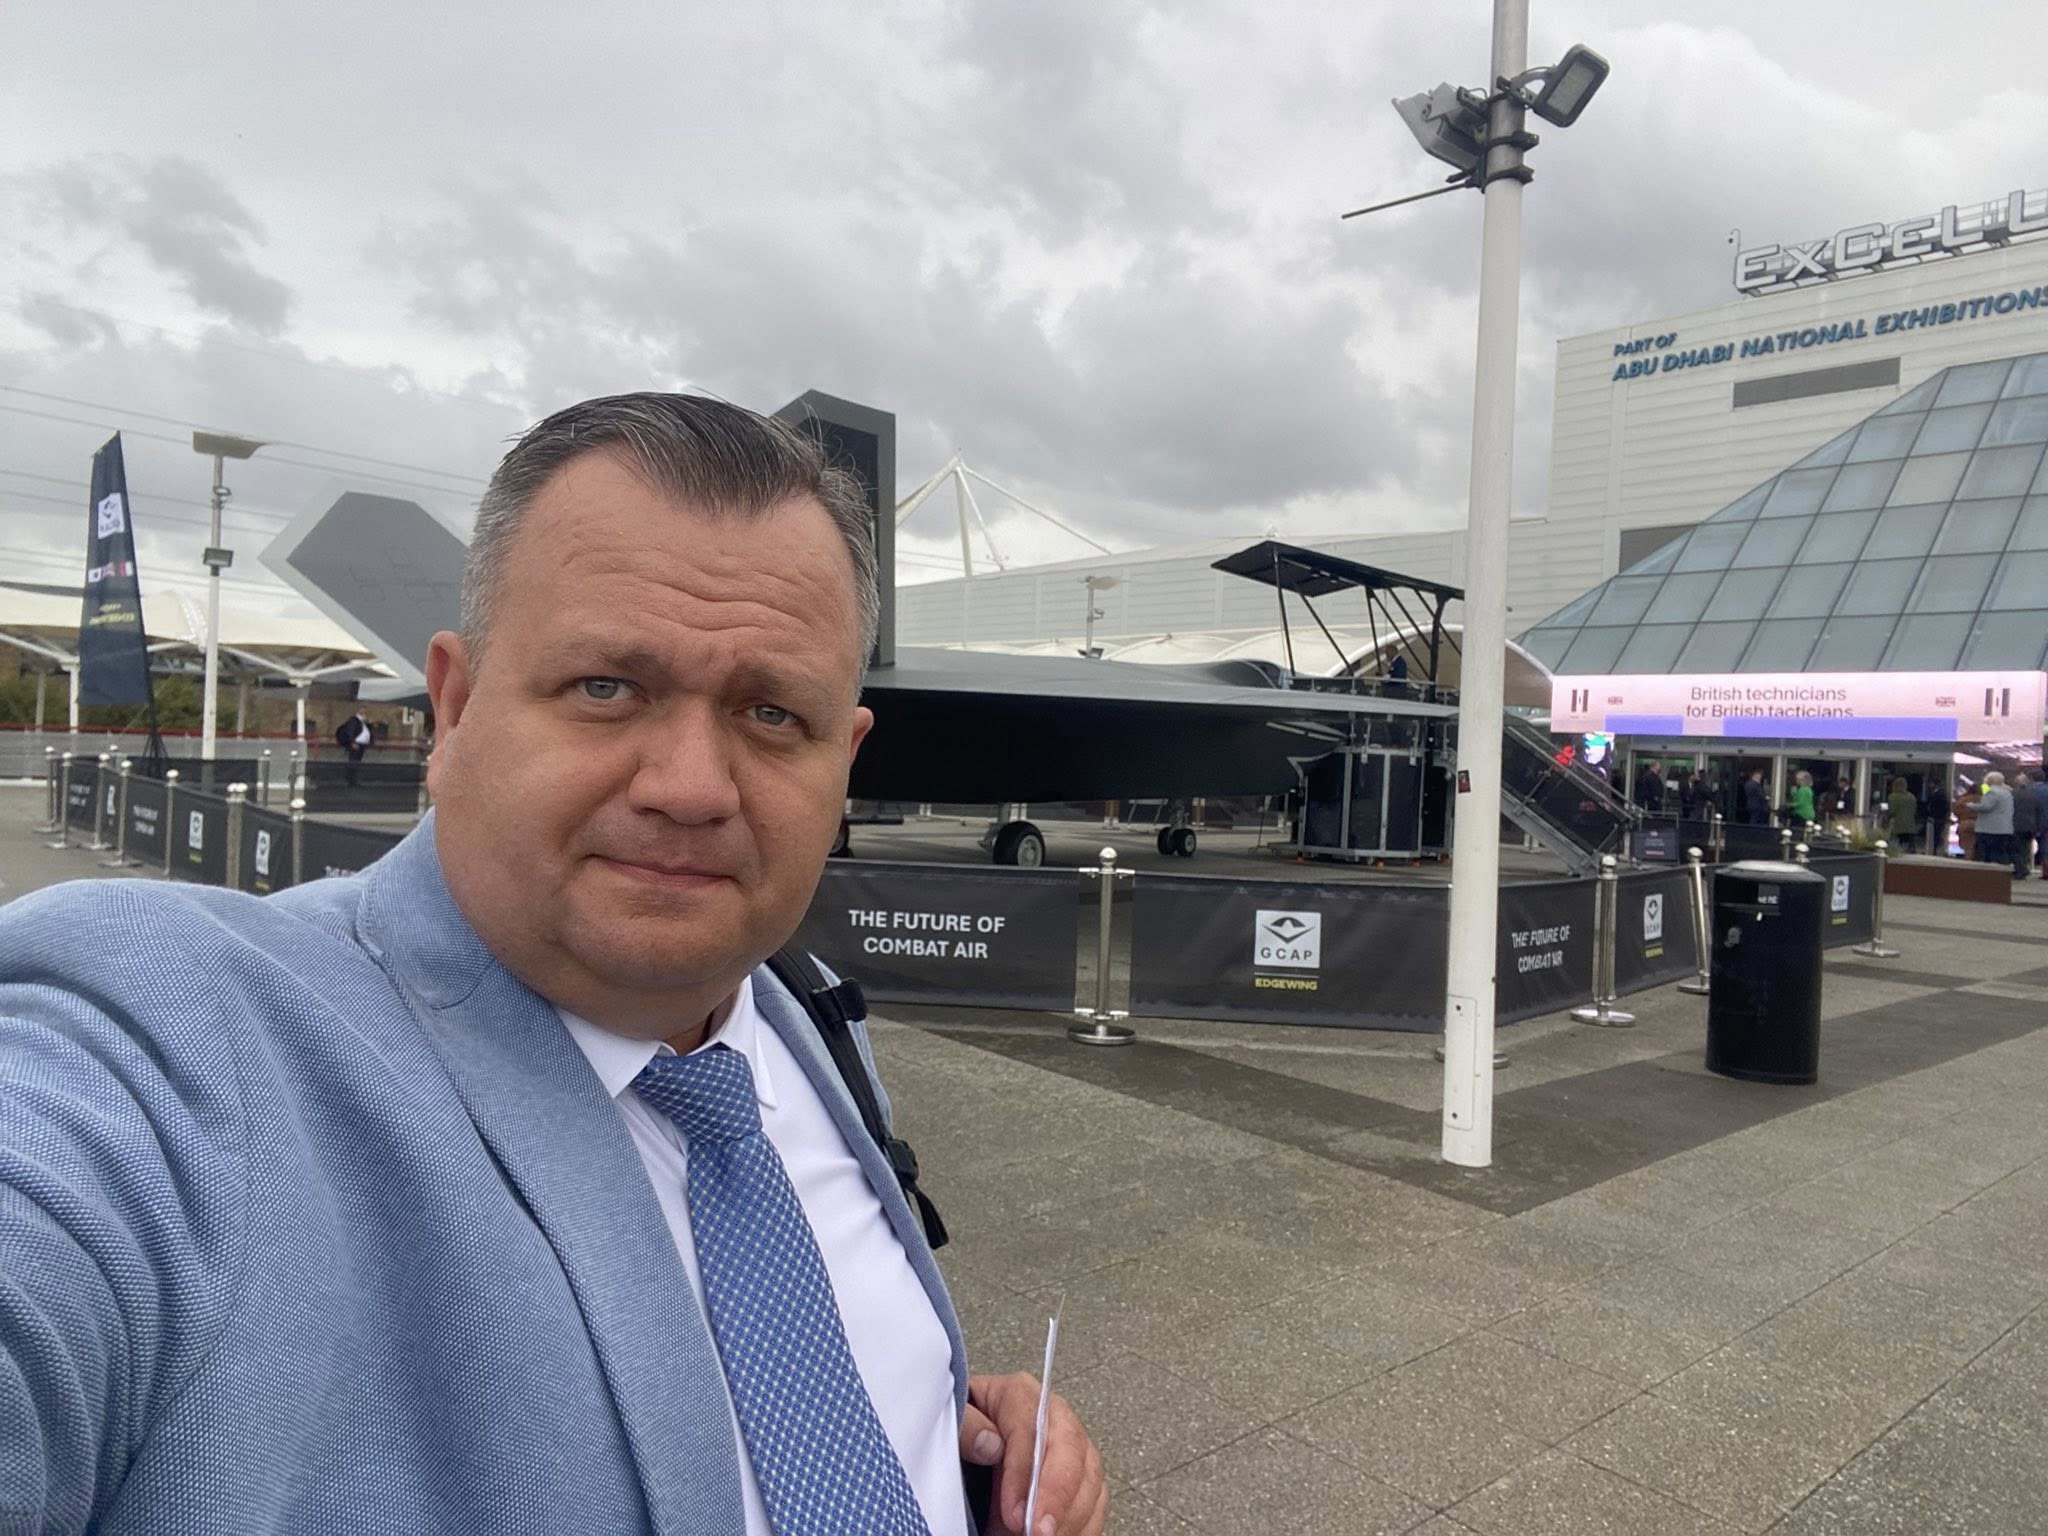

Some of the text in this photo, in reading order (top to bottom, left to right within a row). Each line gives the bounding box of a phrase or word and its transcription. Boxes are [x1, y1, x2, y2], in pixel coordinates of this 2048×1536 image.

[1612, 356, 1659, 381] ABU
[1662, 343, 1735, 373] DHABI
[1740, 319, 1868, 358] NATIONAL
[1613, 333, 1678, 357] PART OF
[1691, 686, 1847, 701] British technicians
[1686, 704, 1854, 718] for British tacticians
[849, 909, 1006, 933] THE FUTURE OF
[863, 936, 989, 959] COMBAT AIR
[1511, 924, 1571, 949] THE FUTURE OF
[1260, 947, 1313, 961] GCAP
[1518, 952, 1551, 973] COMBAT
[1255, 978, 1318, 991] EDGEWING
